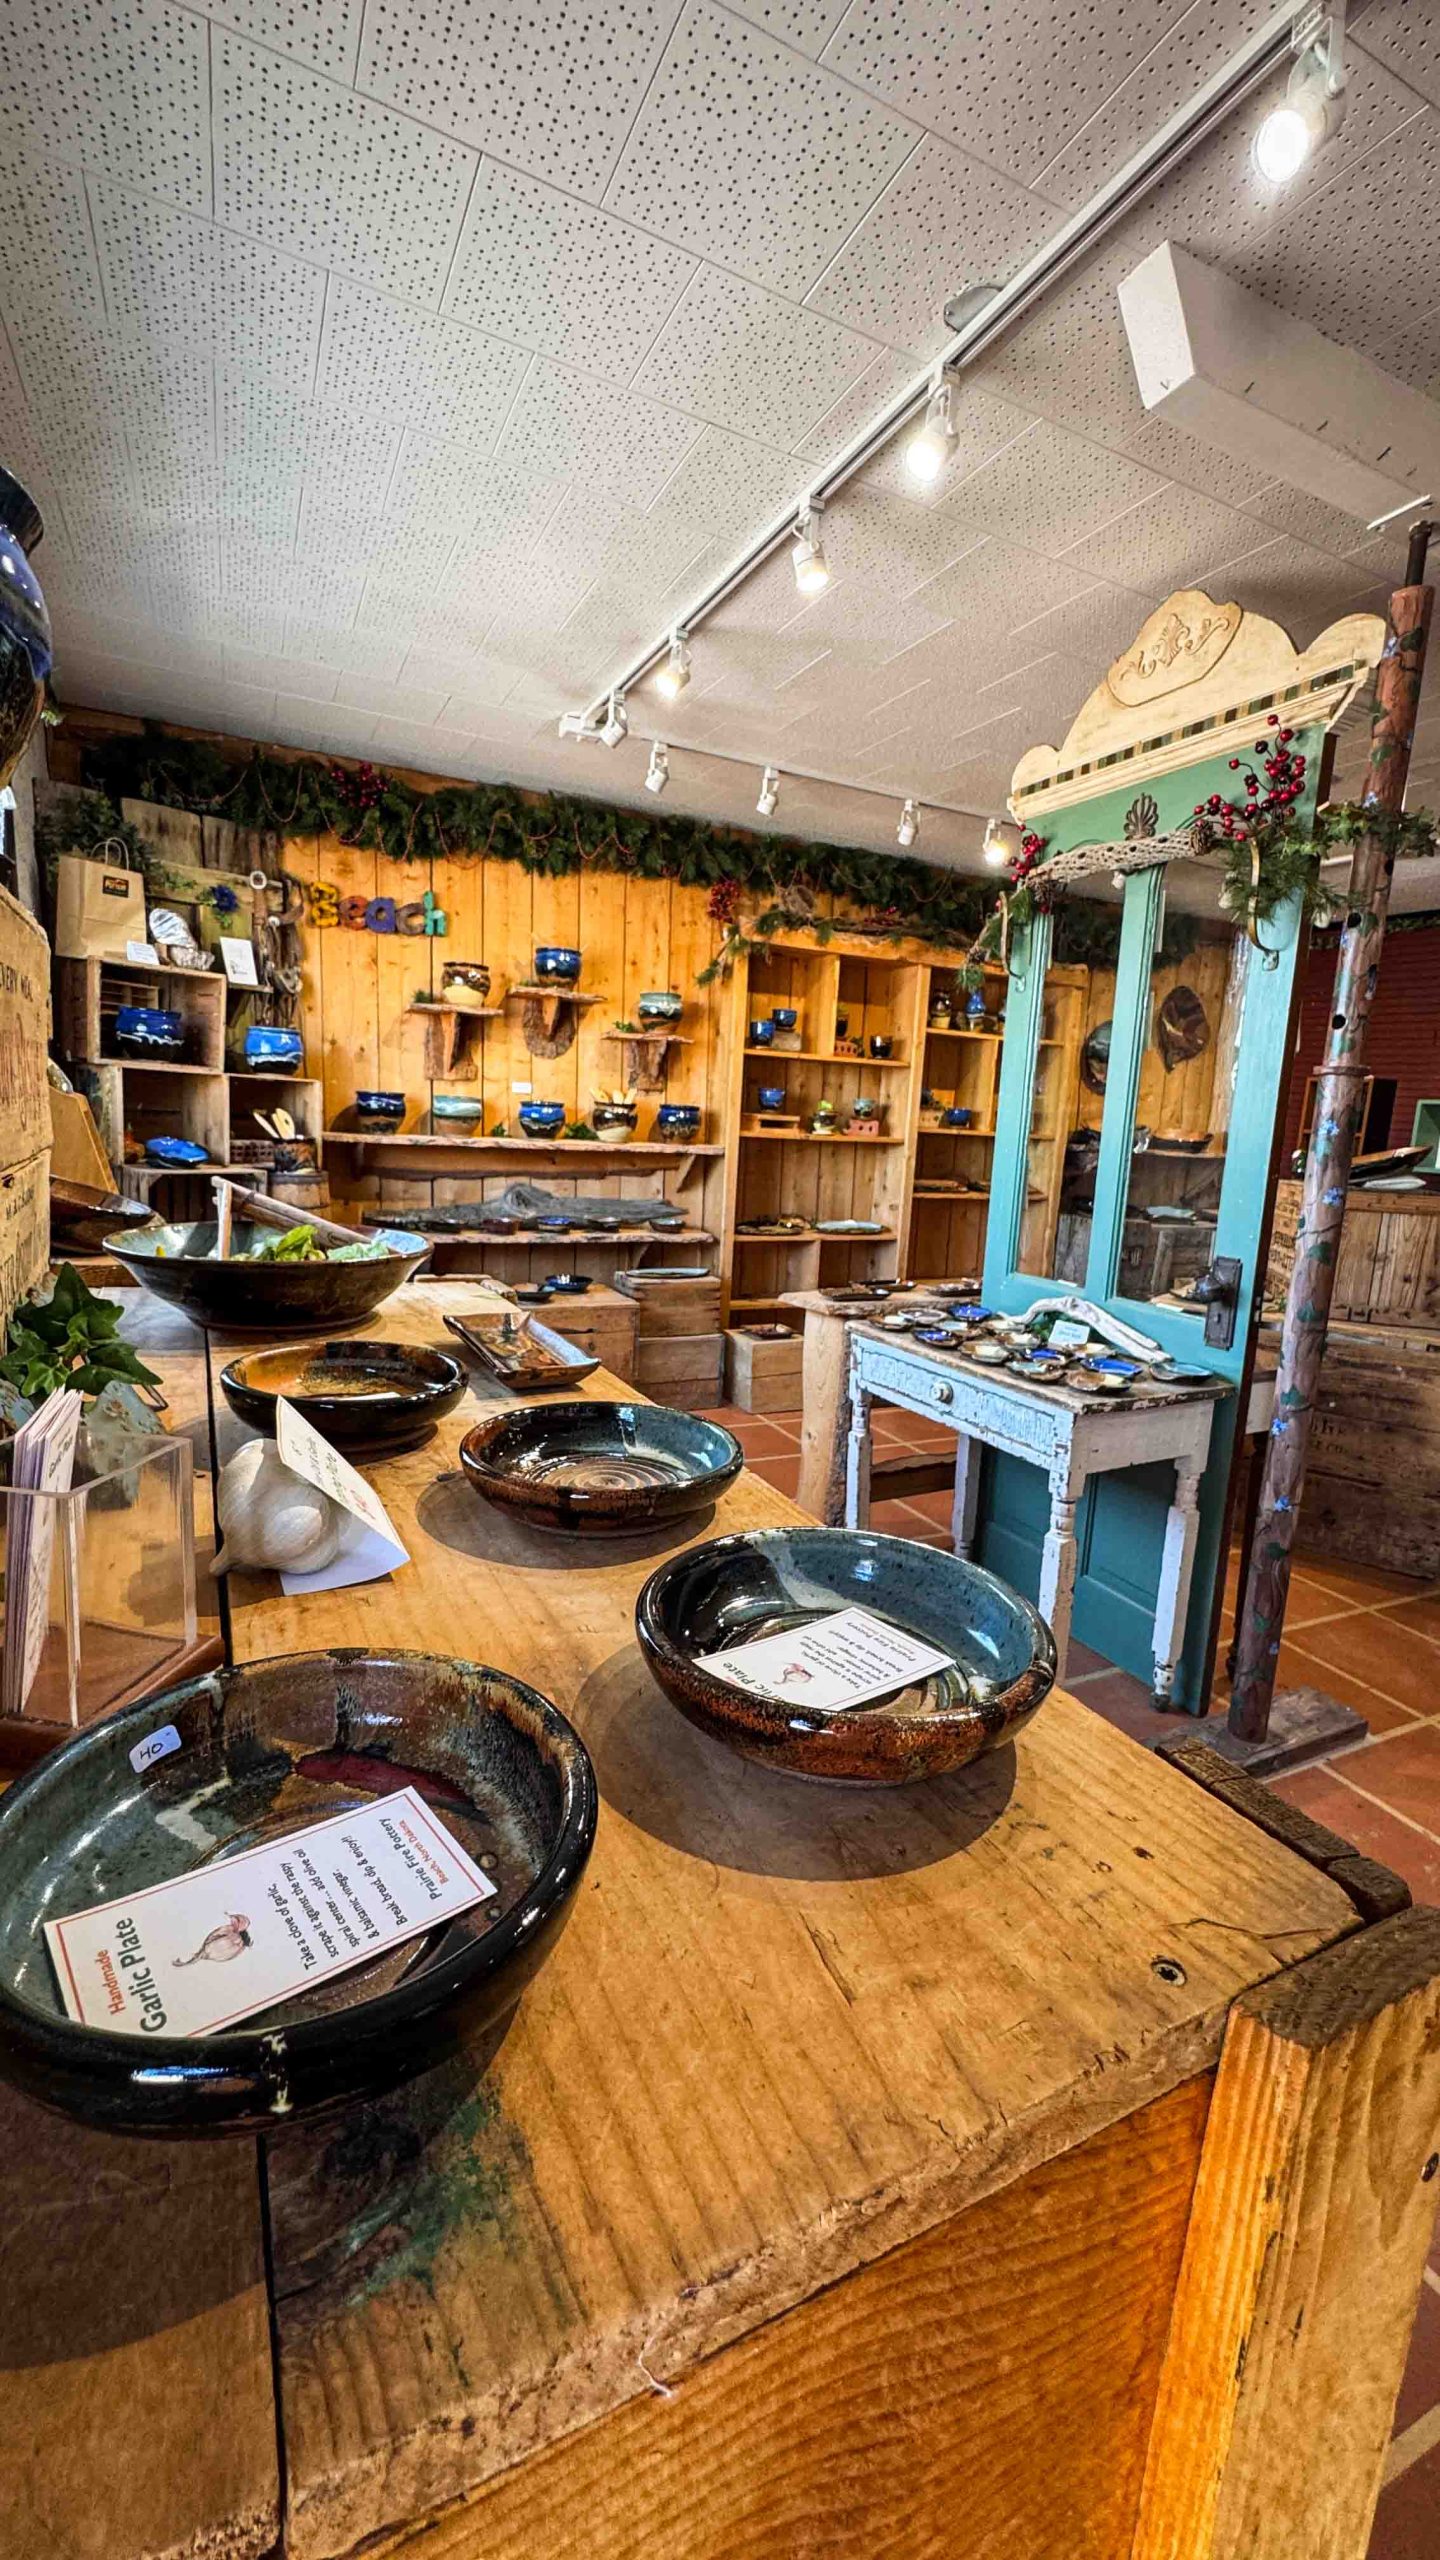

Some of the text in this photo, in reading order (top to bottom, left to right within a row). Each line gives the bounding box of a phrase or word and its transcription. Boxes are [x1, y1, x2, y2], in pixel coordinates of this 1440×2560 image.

[305, 881, 447, 937] Beach
[722, 1661, 756, 1685] Plate
[140, 1742, 164, 1760] 40
[292, 1848, 306, 1858] oil
[302, 1858, 316, 1876] olive
[309, 1876, 325, 1891] add
[341, 1835, 408, 1925] Break bread, dip & enjoy!!
[379, 1818, 442, 1900] Prairie Fire Pottery
[399, 1819, 449, 1885] Beach, North Dakota
[268, 1882, 317, 1970] Take a clove of garlic,
[280, 1862, 339, 1958] scrape it against the raspy
[332, 1868, 380, 1939] & balsamic vinegar.
[338, 1925, 360, 1947] spiral
[95, 1949, 126, 2015] Handmade
[115, 1917, 167, 2032] Garlic Plate
